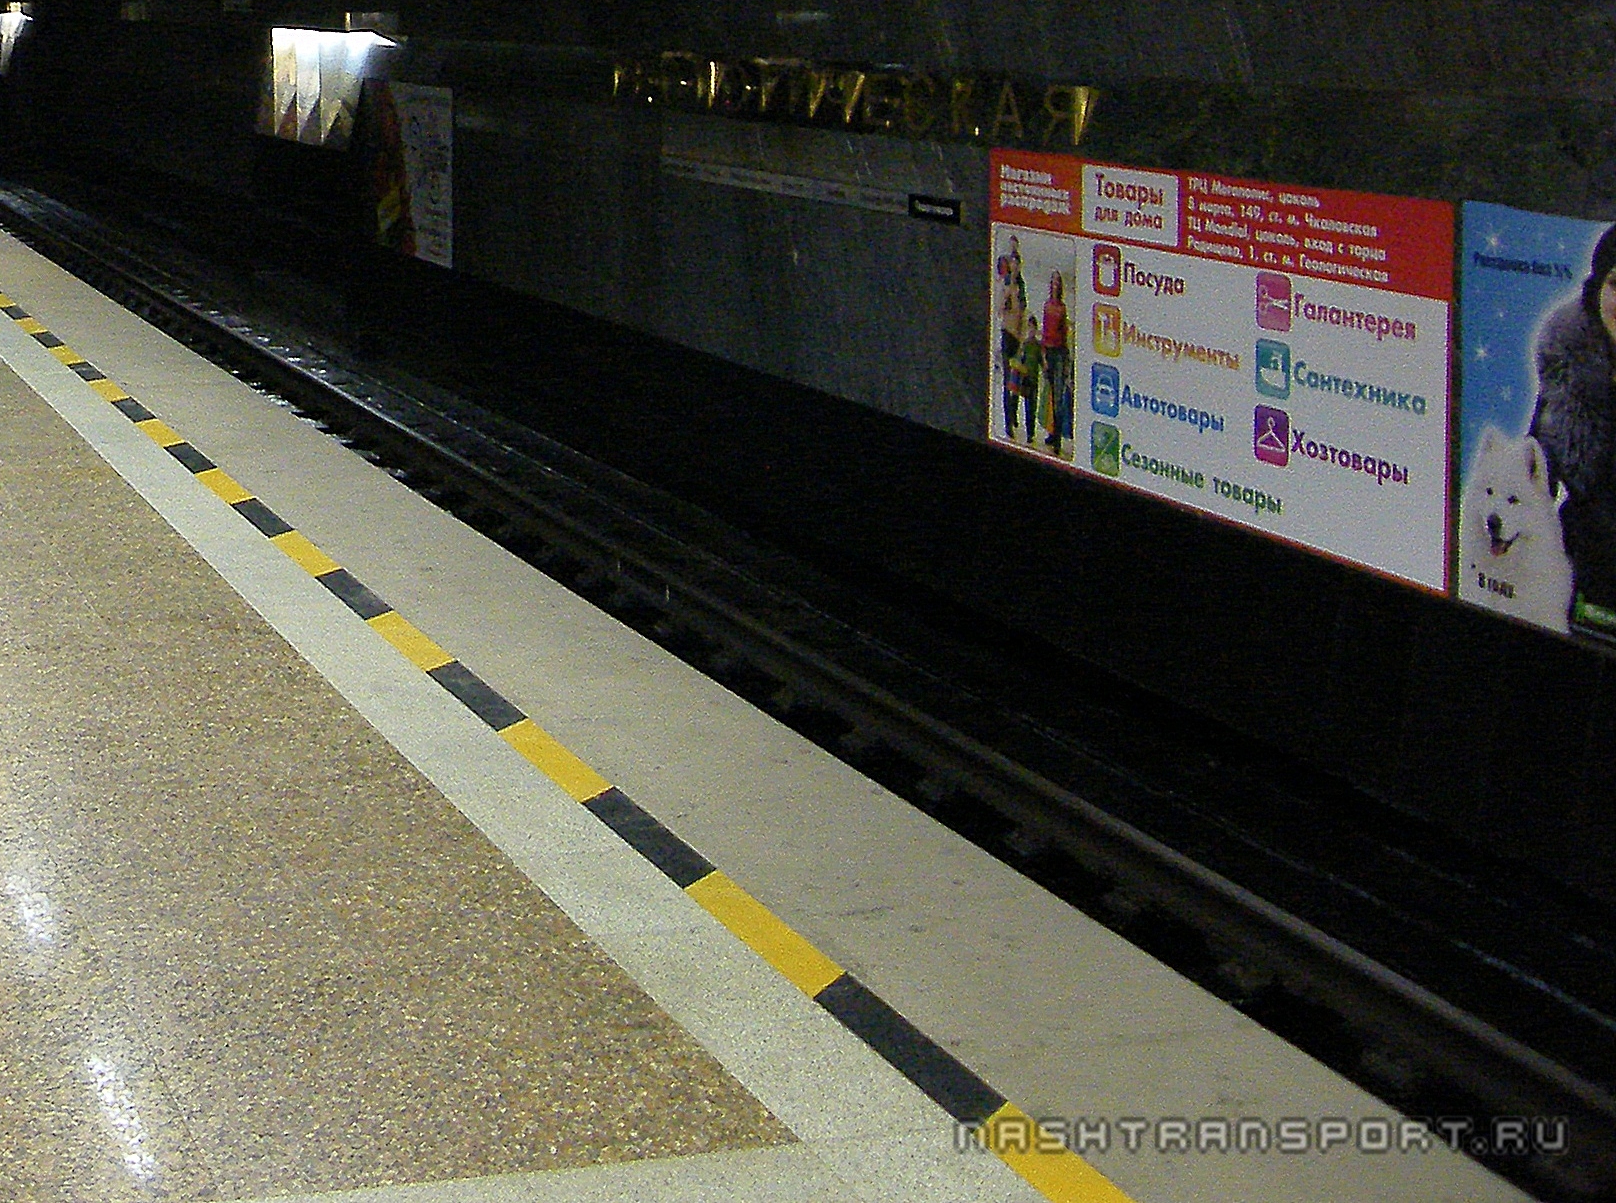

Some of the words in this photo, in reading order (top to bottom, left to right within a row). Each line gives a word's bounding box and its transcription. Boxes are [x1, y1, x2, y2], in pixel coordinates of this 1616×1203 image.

[1094, 172, 1164, 210] Товары
[1094, 206, 1119, 222] для
[1124, 210, 1164, 229] дома
[1240, 203, 1264, 224] 149,
[1304, 212, 1379, 237] Чкаловская
[1298, 253, 1389, 283] Геологическая
[1304, 237, 1333, 254] вход
[1347, 243, 1386, 262] торца
[1123, 261, 1185, 296] Посуда
[1293, 292, 1418, 341] Галантерея
[1123, 321, 1241, 370] Инструменты
[1121, 384, 1225, 433] Автотовары
[1293, 359, 1427, 415] Сантехника
[1291, 428, 1409, 485] Хозтовары
[1122, 443, 1205, 489] Сезонные
[1212, 476, 1284, 515] товары
